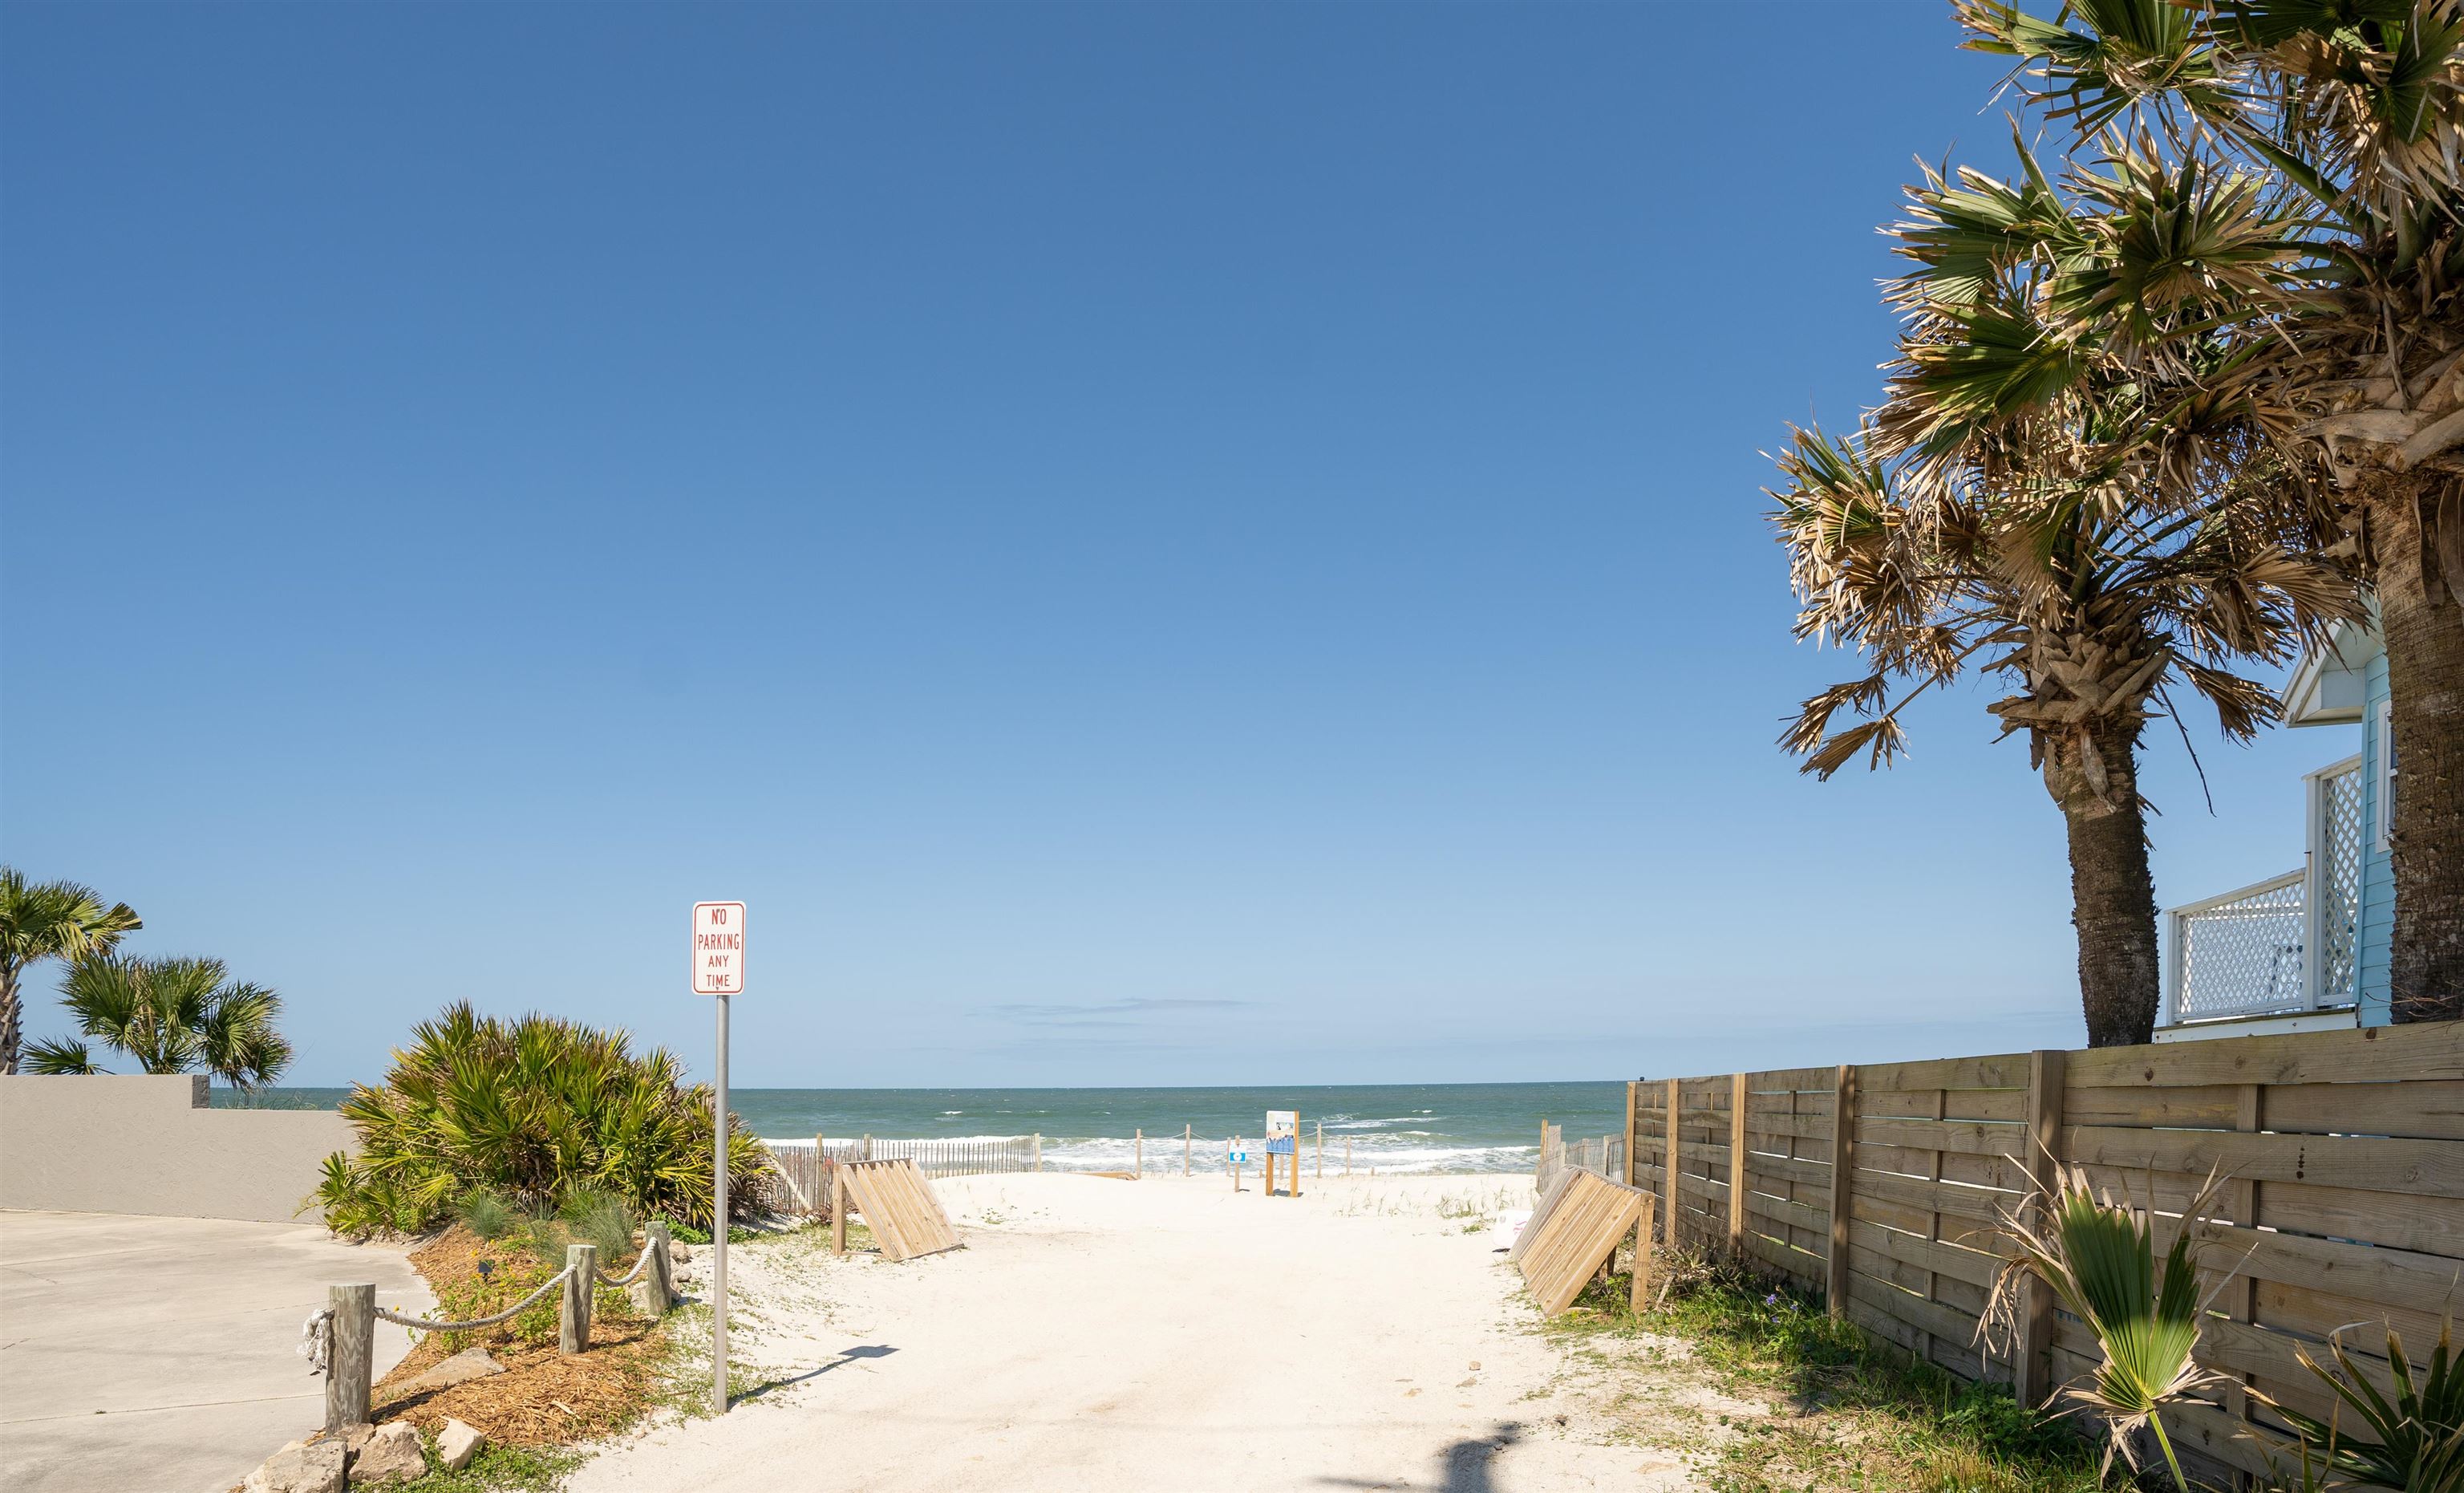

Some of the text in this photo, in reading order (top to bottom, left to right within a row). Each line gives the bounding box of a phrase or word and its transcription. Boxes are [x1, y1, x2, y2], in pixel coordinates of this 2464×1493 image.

[711, 908, 727, 925] NO
[698, 933, 740, 951] PARKING
[708, 955, 729, 968] ANY
[707, 974, 731, 987] TIME
